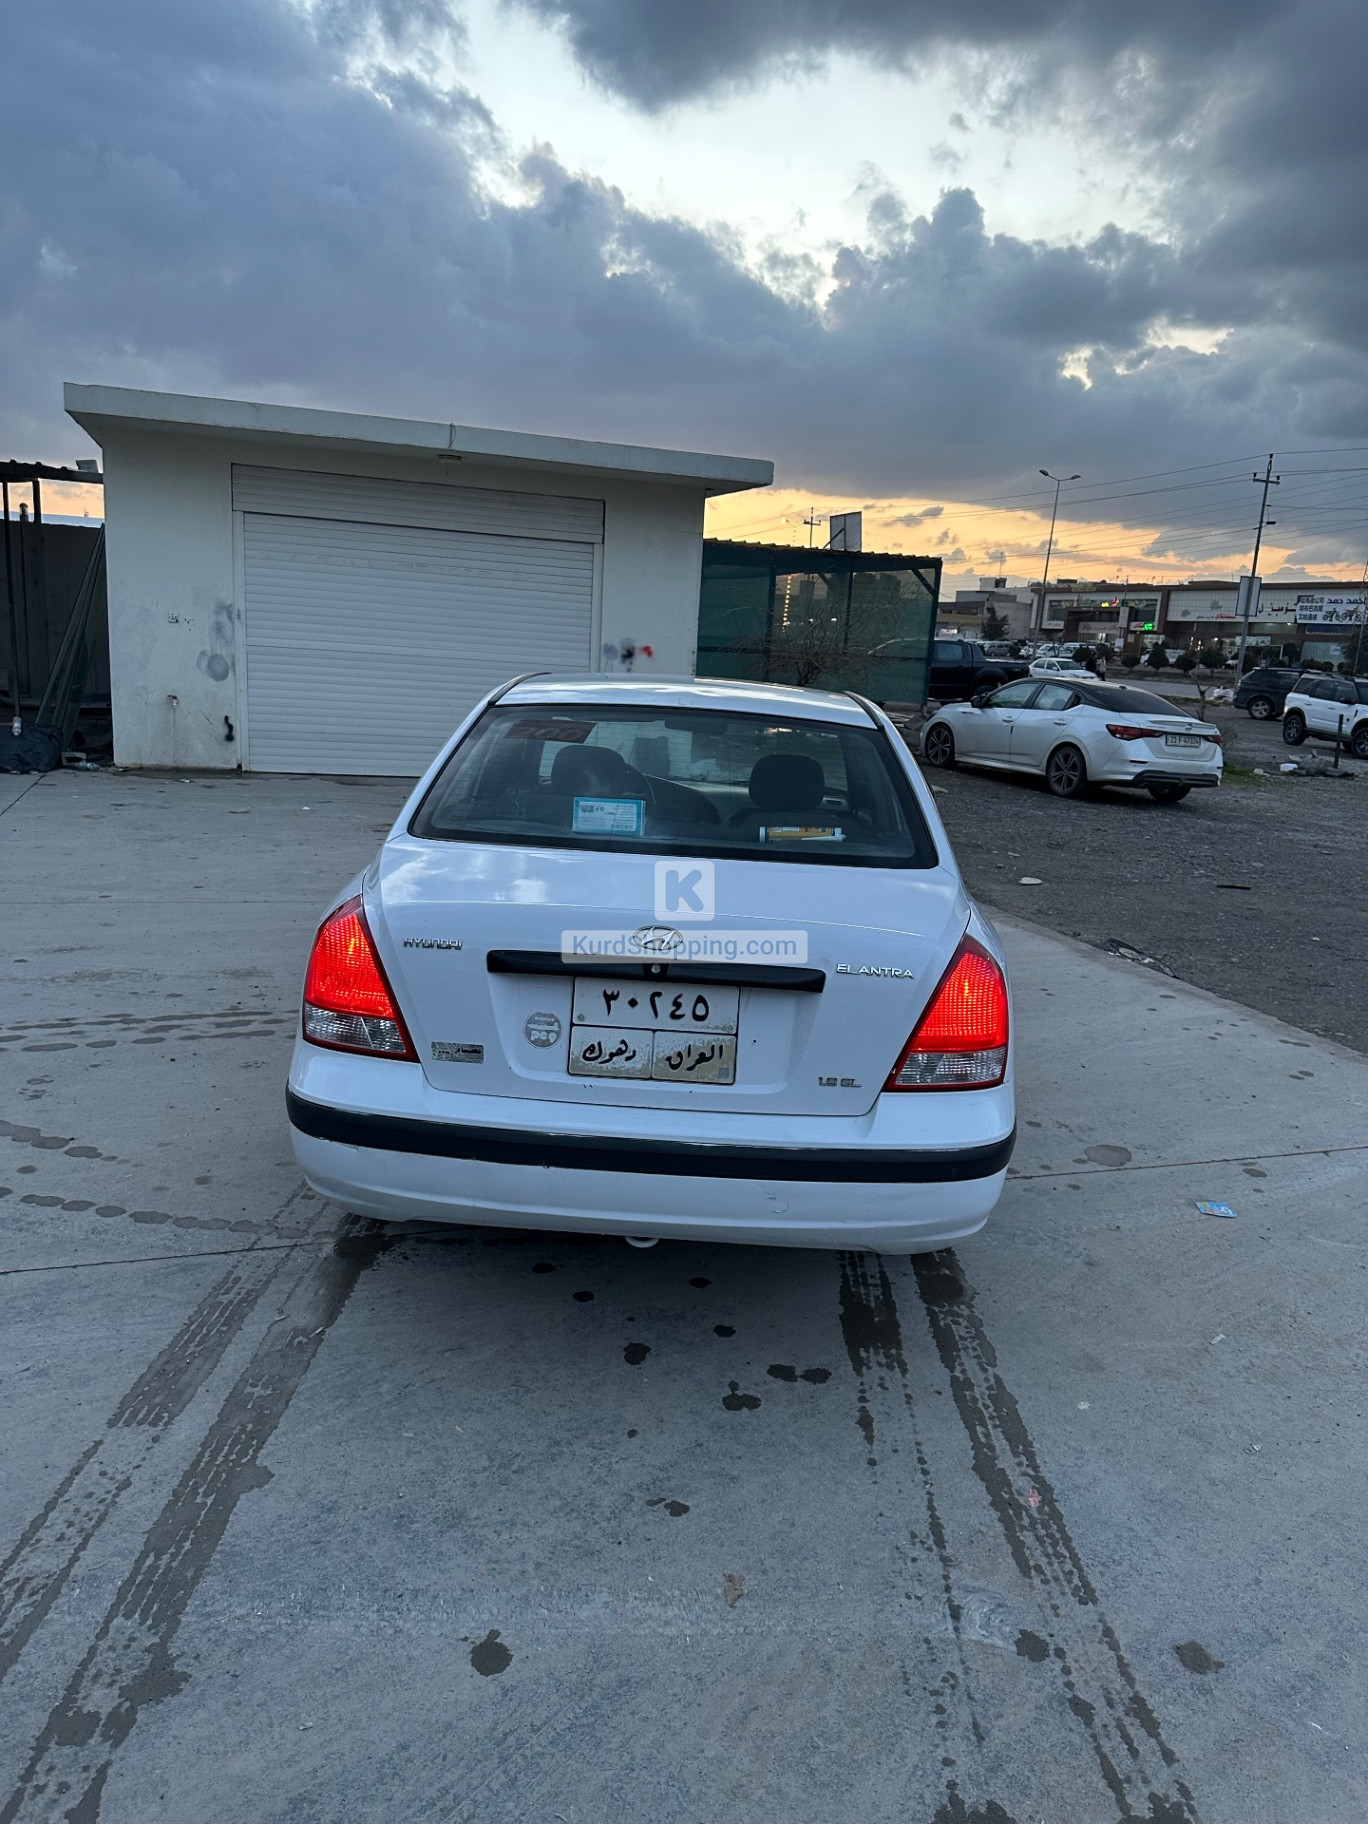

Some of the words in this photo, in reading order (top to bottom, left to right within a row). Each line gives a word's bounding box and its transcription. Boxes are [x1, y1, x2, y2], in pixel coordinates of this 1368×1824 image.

[404, 937, 463, 950] HYUNDAI
[836, 963, 914, 979] ELANTRA
[582, 1039, 637, 1064] دهوك
[666, 1044, 724, 1071] العراق
